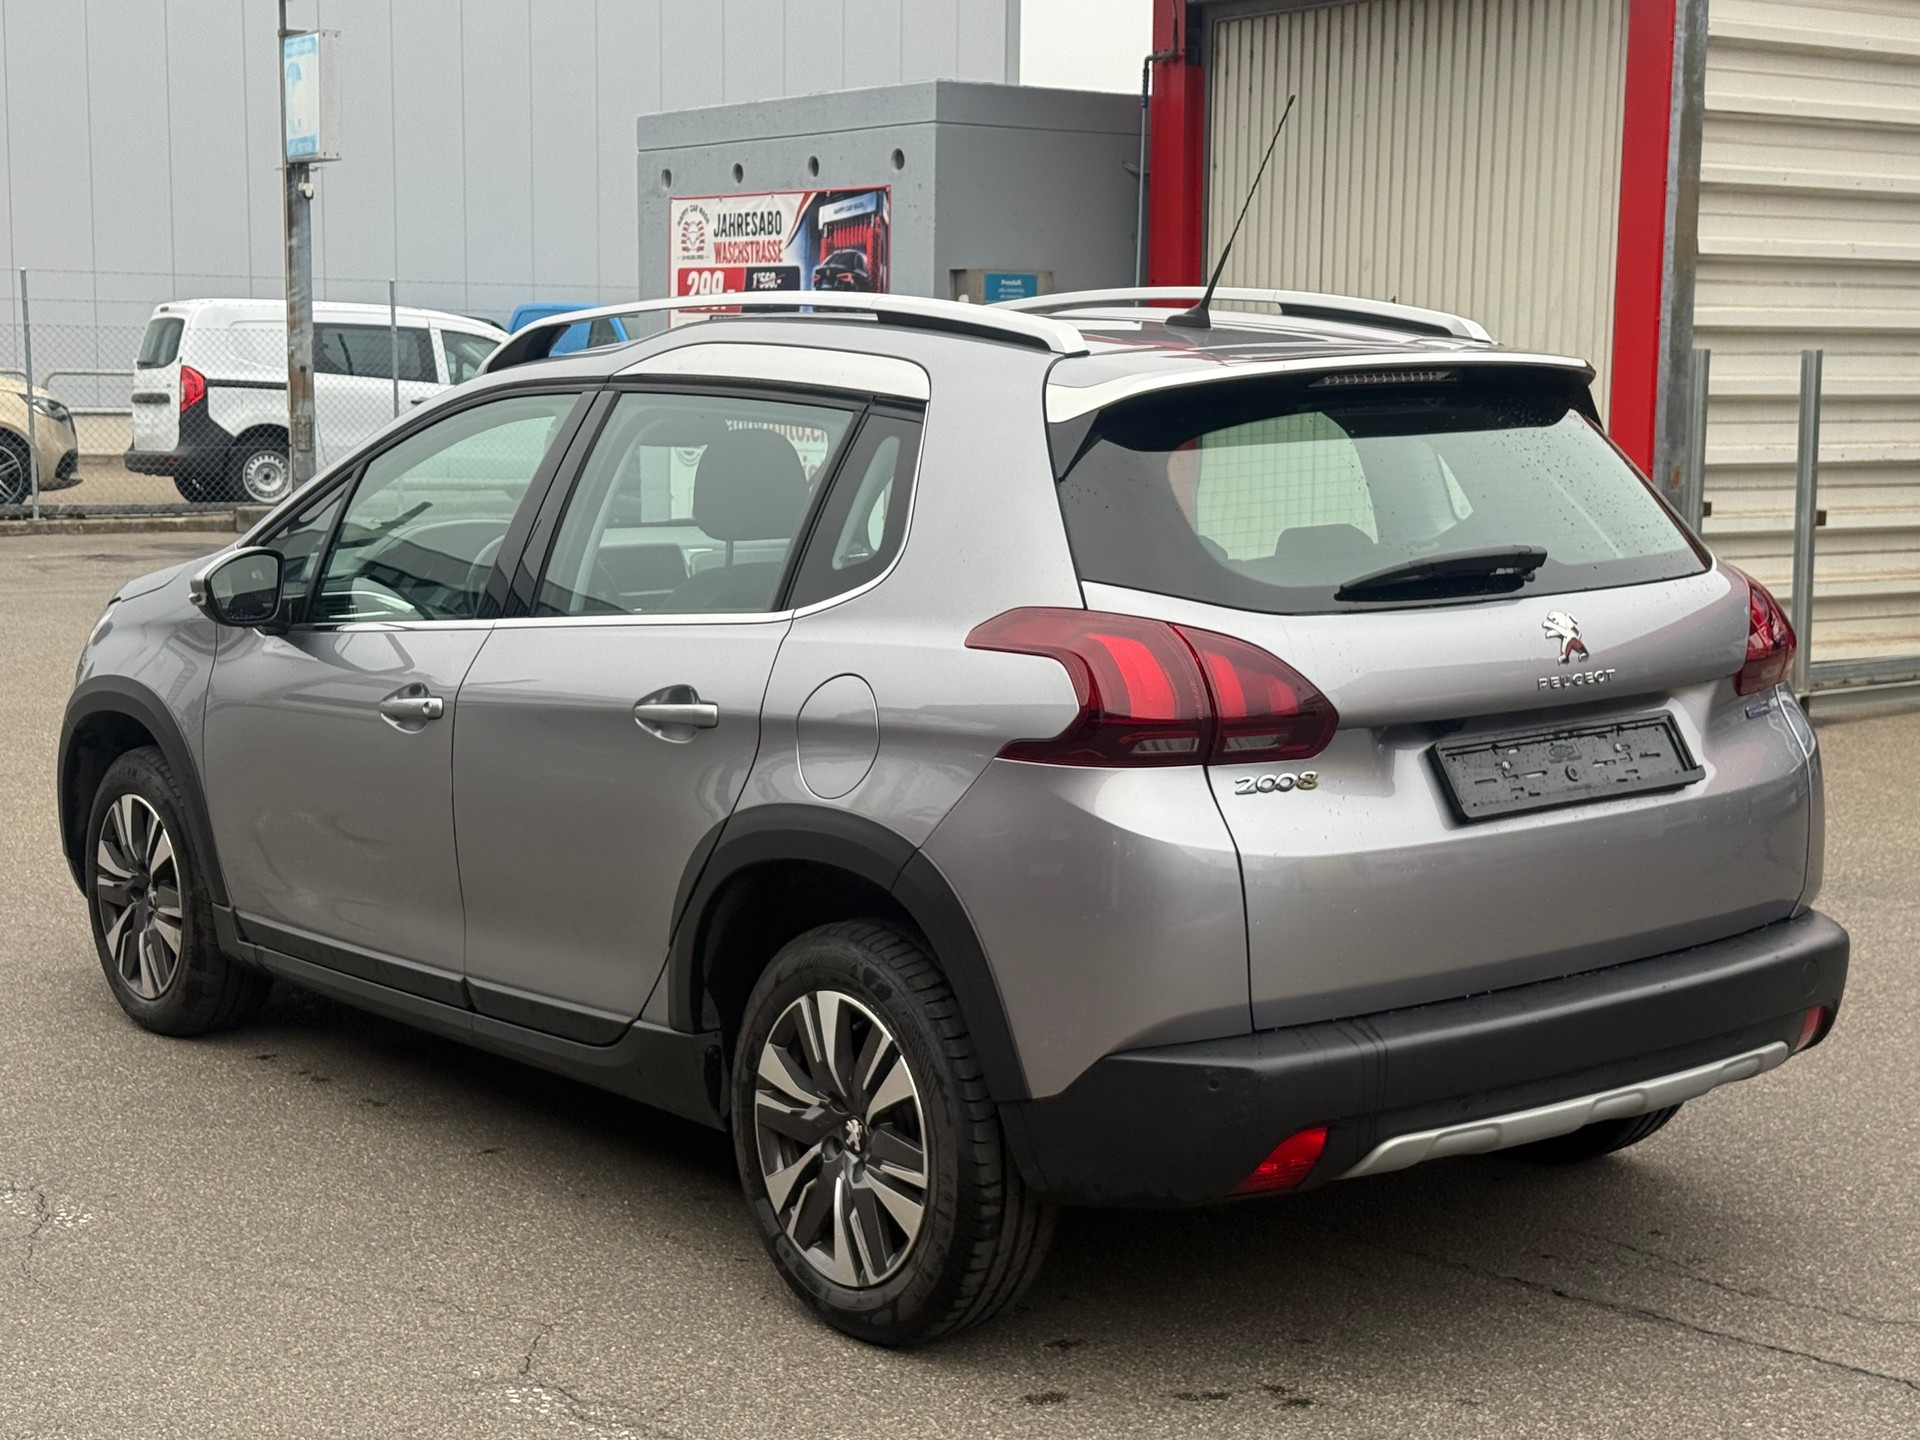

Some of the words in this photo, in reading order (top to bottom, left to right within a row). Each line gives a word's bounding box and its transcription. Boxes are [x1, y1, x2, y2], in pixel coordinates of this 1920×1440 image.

[713, 210, 782, 238] JAHRESABO
[713, 239, 784, 264] WASCHSTRASSE
[1538, 669, 1616, 690] PEUGEOT
[1235, 770, 1318, 796] 2008
